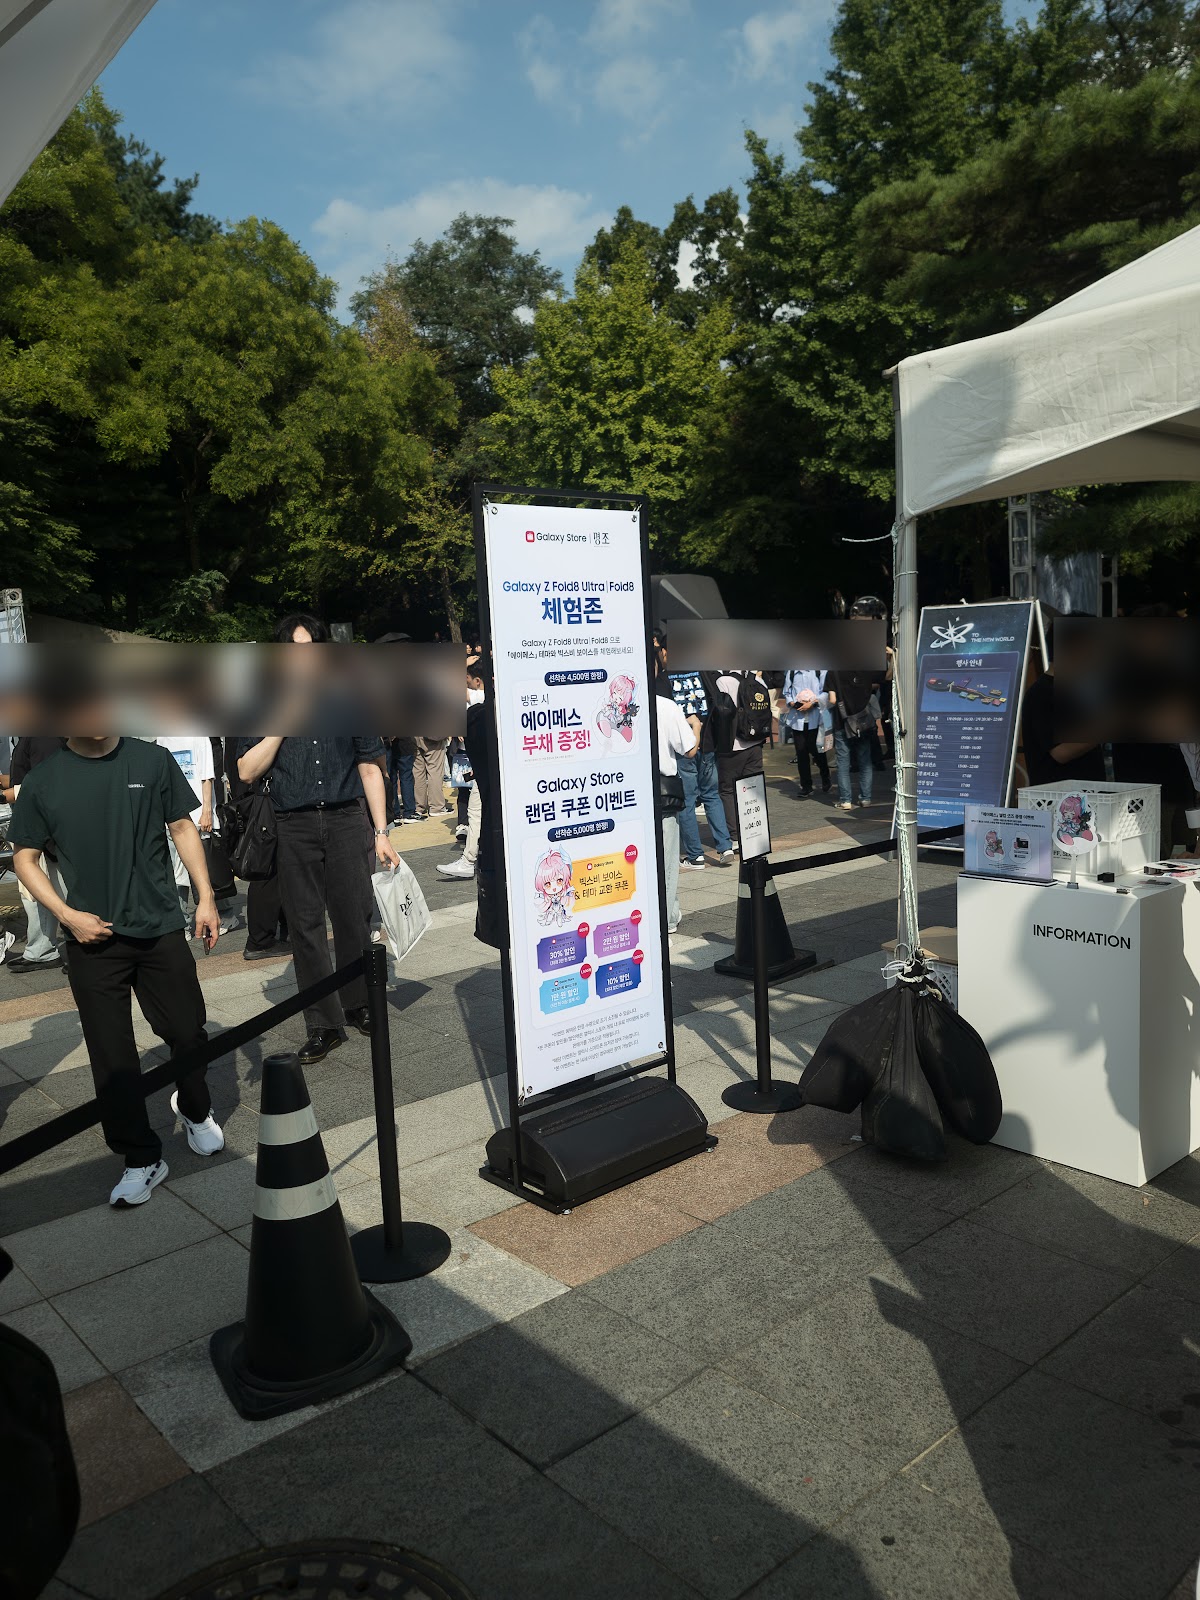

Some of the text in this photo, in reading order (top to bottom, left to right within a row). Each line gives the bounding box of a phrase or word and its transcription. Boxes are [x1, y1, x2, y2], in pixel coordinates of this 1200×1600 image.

[536, 532, 565, 544] Galaxy
[566, 533, 587, 542] Store
[502, 581, 541, 595] Galaxy
[544, 581, 550, 592] Z
[552, 581, 580, 592] Fold8
[541, 597, 604, 625] 체험존
[521, 639, 546, 648] Galaxy
[548, 638, 552, 646] Z
[553, 638, 572, 646] Fold8
[538, 650, 556, 658] 테마와
[557, 649, 575, 658] 빅스비
[576, 648, 599, 657] 보이스를
[969, 658, 982, 667] 안내
[548, 670, 604, 683] 선착순 4,500명 한정!
[521, 693, 549, 707] 방문 시
[521, 708, 583, 731] 에이메스
[522, 729, 591, 755] 부채 증정!
[537, 771, 624, 794] Galaxy Store
[525, 790, 637, 824] 랜덤 쿠폰 이벤트
[554, 821, 609, 839] 선착순 5,000명 한정!
[579, 870, 623, 887] 빅스비 보이스
[583, 886, 597, 898] 테마
[599, 884, 613, 895] 교환
[615, 881, 629, 891] 쿠폰
[1033, 924, 1131, 950] INFORMATION
[550, 946, 576, 960] 30% 할인
[607, 973, 630, 985] 10% 할인
[567, 987, 579, 997] 할인
